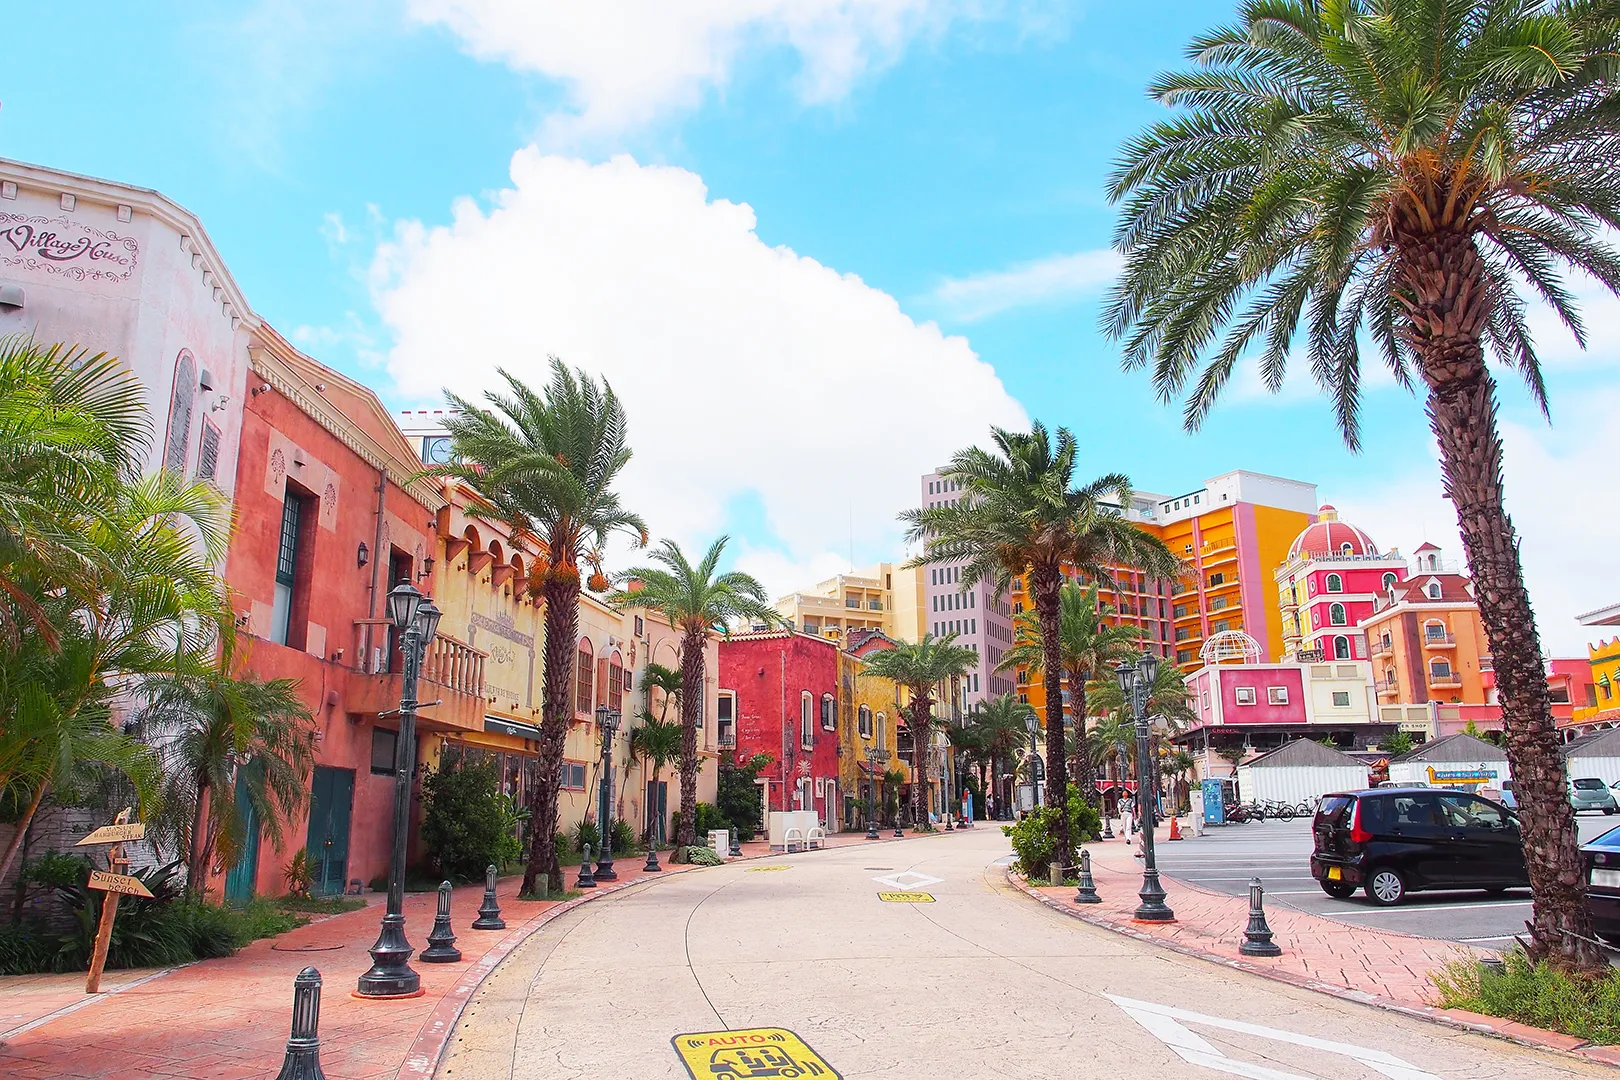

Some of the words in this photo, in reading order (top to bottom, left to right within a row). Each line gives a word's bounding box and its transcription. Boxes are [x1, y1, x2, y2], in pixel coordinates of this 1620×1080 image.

[0, 225, 80, 254] Village
[68, 236, 129, 265] House
[708, 1034, 766, 1046] AUTO
